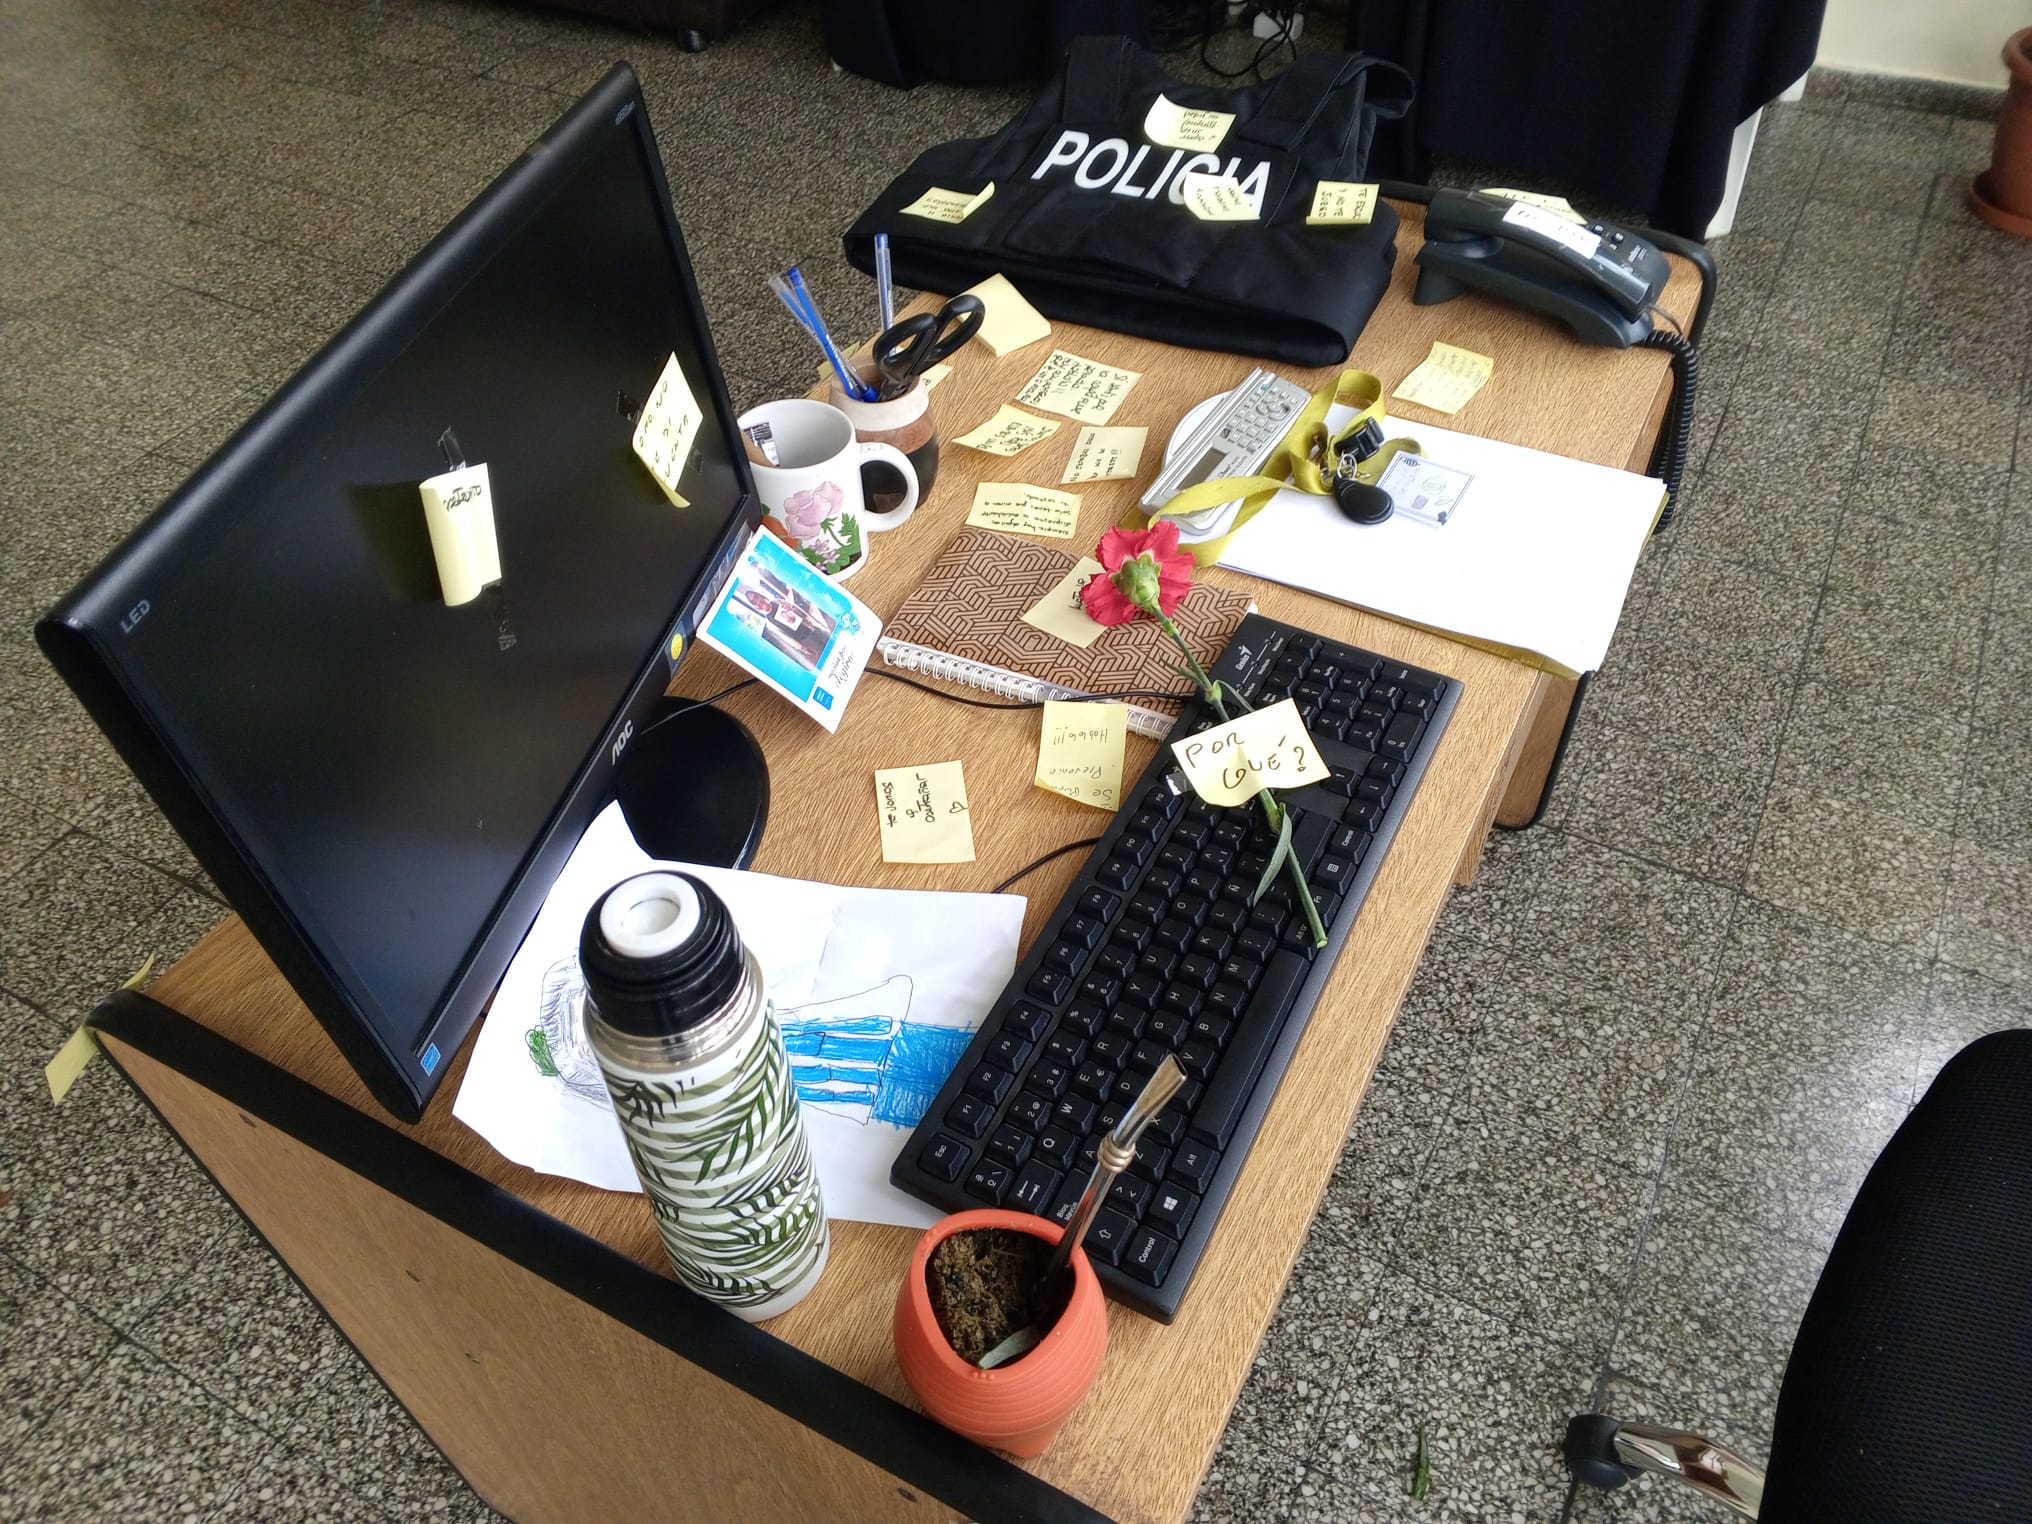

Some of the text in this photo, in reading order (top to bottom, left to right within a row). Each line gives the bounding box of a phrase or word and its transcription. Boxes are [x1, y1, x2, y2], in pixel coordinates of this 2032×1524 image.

[664, 414, 689, 478] UENTA
[120, 598, 152, 636] LED
[611, 719, 635, 767] AOC
[1185, 732, 1245, 769] POR
[1050, 766, 1102, 779] Prevenir
[1092, 788, 1113, 801] Se
[886, 814, 898, 828] te
[1200, 936, 1210, 945] K
[1146, 954, 1157, 964] U
[1228, 962, 1240, 973] M
[1130, 982, 1141, 992] Y
[1169, 990, 1180, 1001] H
[1214, 992, 1226, 1002] N
[1114, 1012, 1124, 1022] T
[1154, 1020, 1164, 1030] G
[1199, 1022, 1210, 1032] B
[1097, 1041, 1108, 1051] R
[1137, 1052, 1148, 1061] F
[1182, 1052, 1194, 1062] V
[1080, 1072, 1090, 1083] E
[1120, 1082, 1131, 1091] D
[1060, 1102, 1074, 1114] W
[1102, 1114, 1114, 1125] S
[1149, 1116, 1162, 1126] X
[1042, 1136, 1056, 1149] Q
[934, 1144, 948, 1159] Esc
[1186, 1153, 1198, 1168] Alt
[1138, 1236, 1157, 1264] Control
